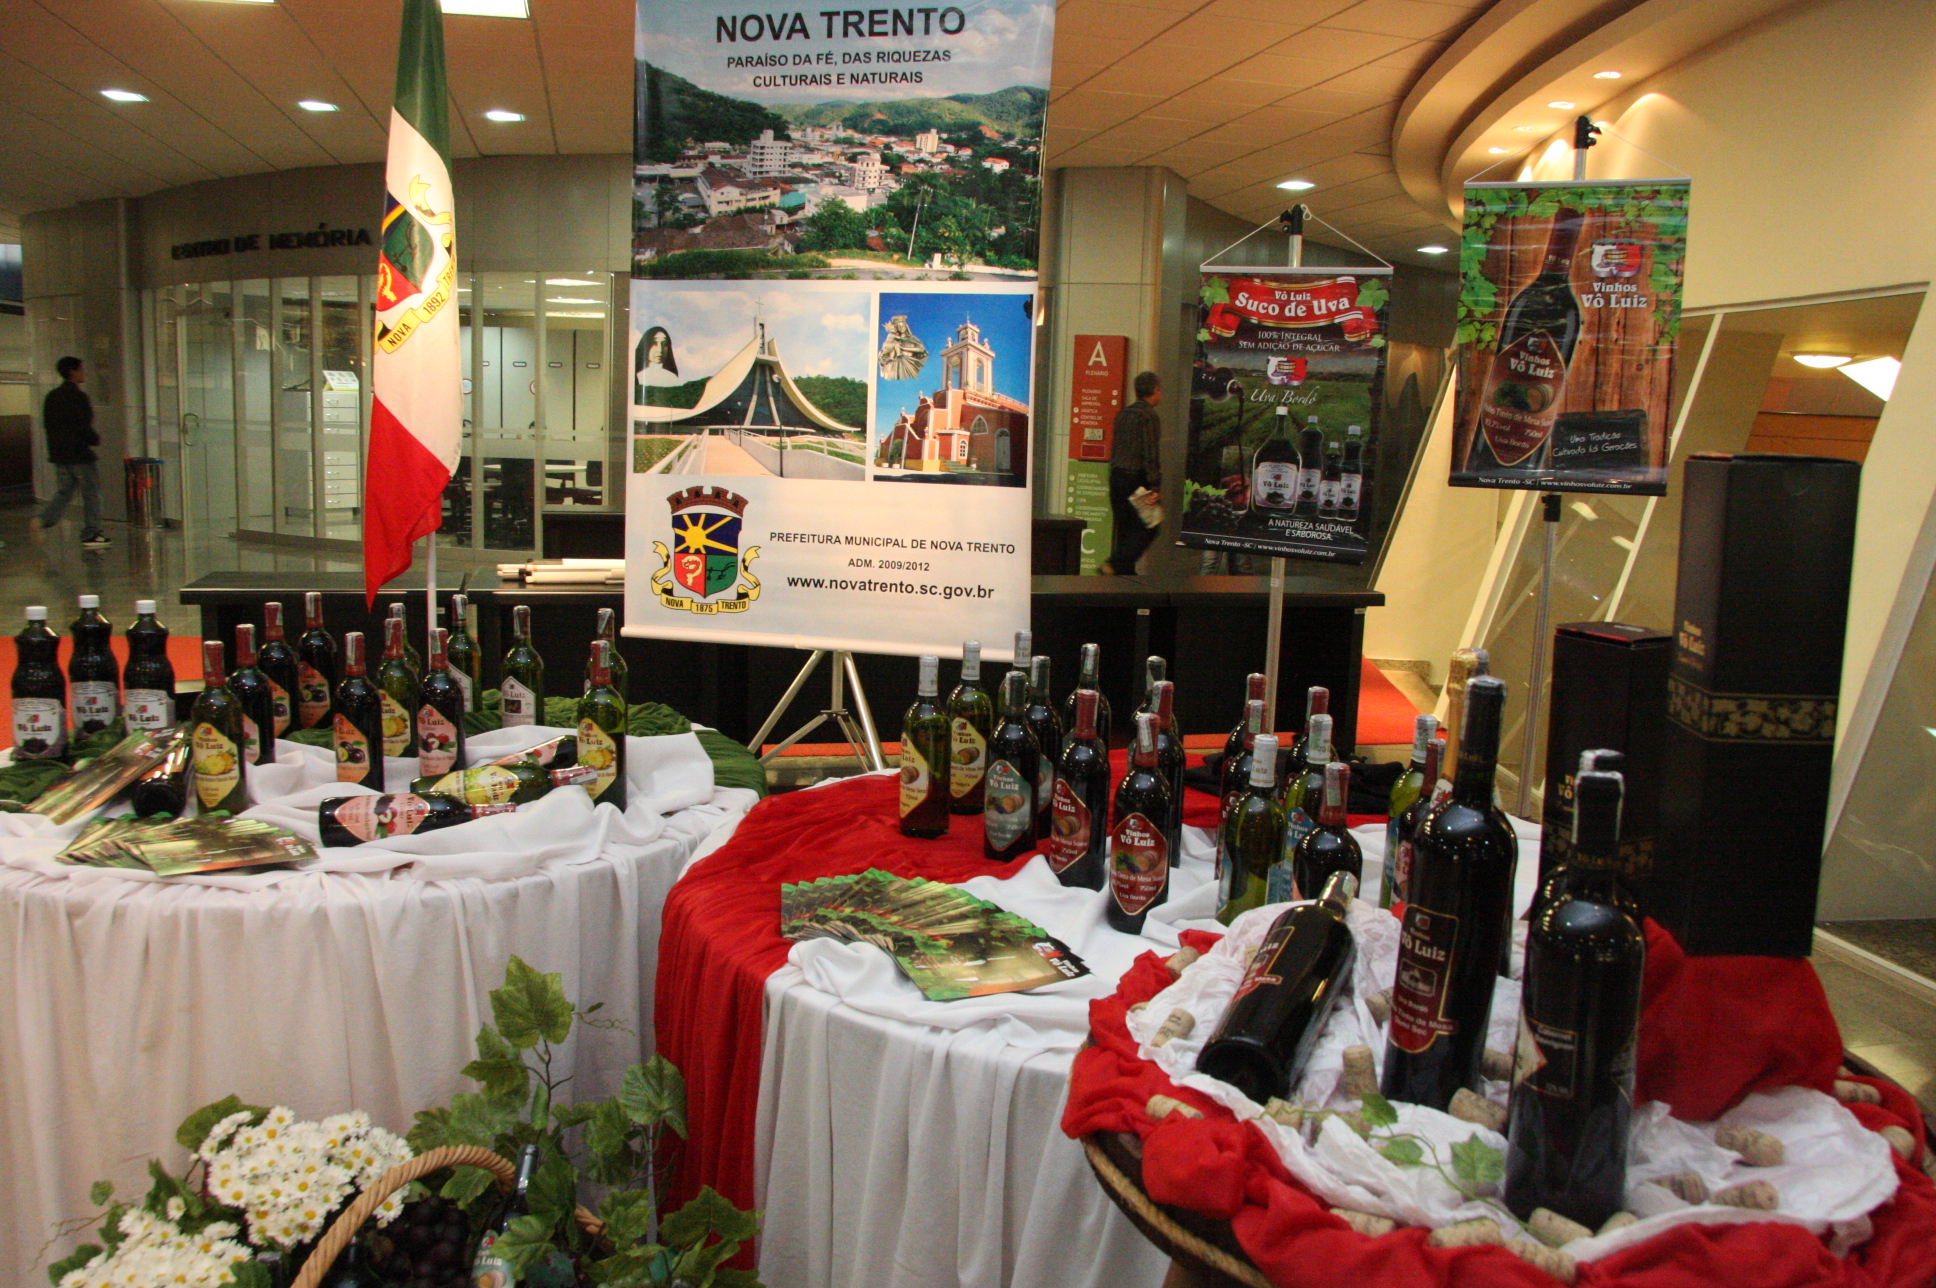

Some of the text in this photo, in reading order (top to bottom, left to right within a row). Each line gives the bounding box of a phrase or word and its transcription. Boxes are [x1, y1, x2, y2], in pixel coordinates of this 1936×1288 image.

[716, 6, 966, 43] NOVA TRENTO
[727, 49, 952, 68] PARAÍSO DA FÉ, DAS RIQUEZAS
[752, 70, 923, 88] CULTURAIS E NATURAIS
[1592, 282, 1638, 293] Vinhos
[1274, 290, 1311, 301] Vô Luiz
[1581, 293, 1648, 309] Vô Luiz
[423, 292, 446, 315] 1892
[1234, 292, 1350, 317] Suco de Uva
[387, 322, 412, 347] NOVA
[1257, 331, 1278, 340] 100%
[1257, 341, 1290, 351] ADIÇÃO
[1292, 343, 1302, 351] DE
[1088, 341, 1107, 367] A
[1520, 351, 1551, 366] Vinhos
[1510, 357, 1556, 379] Vô Luiz
[1250, 388, 1276, 402] Uva
[1478, 477, 1497, 485] Nova
[1498, 477, 1521, 486] Trento
[1275, 519, 1313, 530] NATUREZA
[1315, 521, 1354, 534] SAUDÁVEL
[769, 532, 1016, 555] PREFEITURA MUNICIPAL DE NOVA TRENTO
[1081, 528, 1096, 554] C
[848, 558, 931, 572] ADM. 2009/2012
[787, 575, 995, 600] www.novatrento.sc.gov.br
[665, 597, 684, 608] NOVA
[695, 604, 713, 613] 1875
[721, 600, 747, 610] TRENTO
[89, 706, 109, 714] Luiz
[139, 714, 160, 722] Luiz
[1000, 782, 1020, 791] Luiz
[1058, 802, 1076, 813] Luiz
[1120, 834, 1155, 847] Vô Luiz
[1125, 829, 1151, 838] Vinhos
[1414, 939, 1446, 961] Luiz
